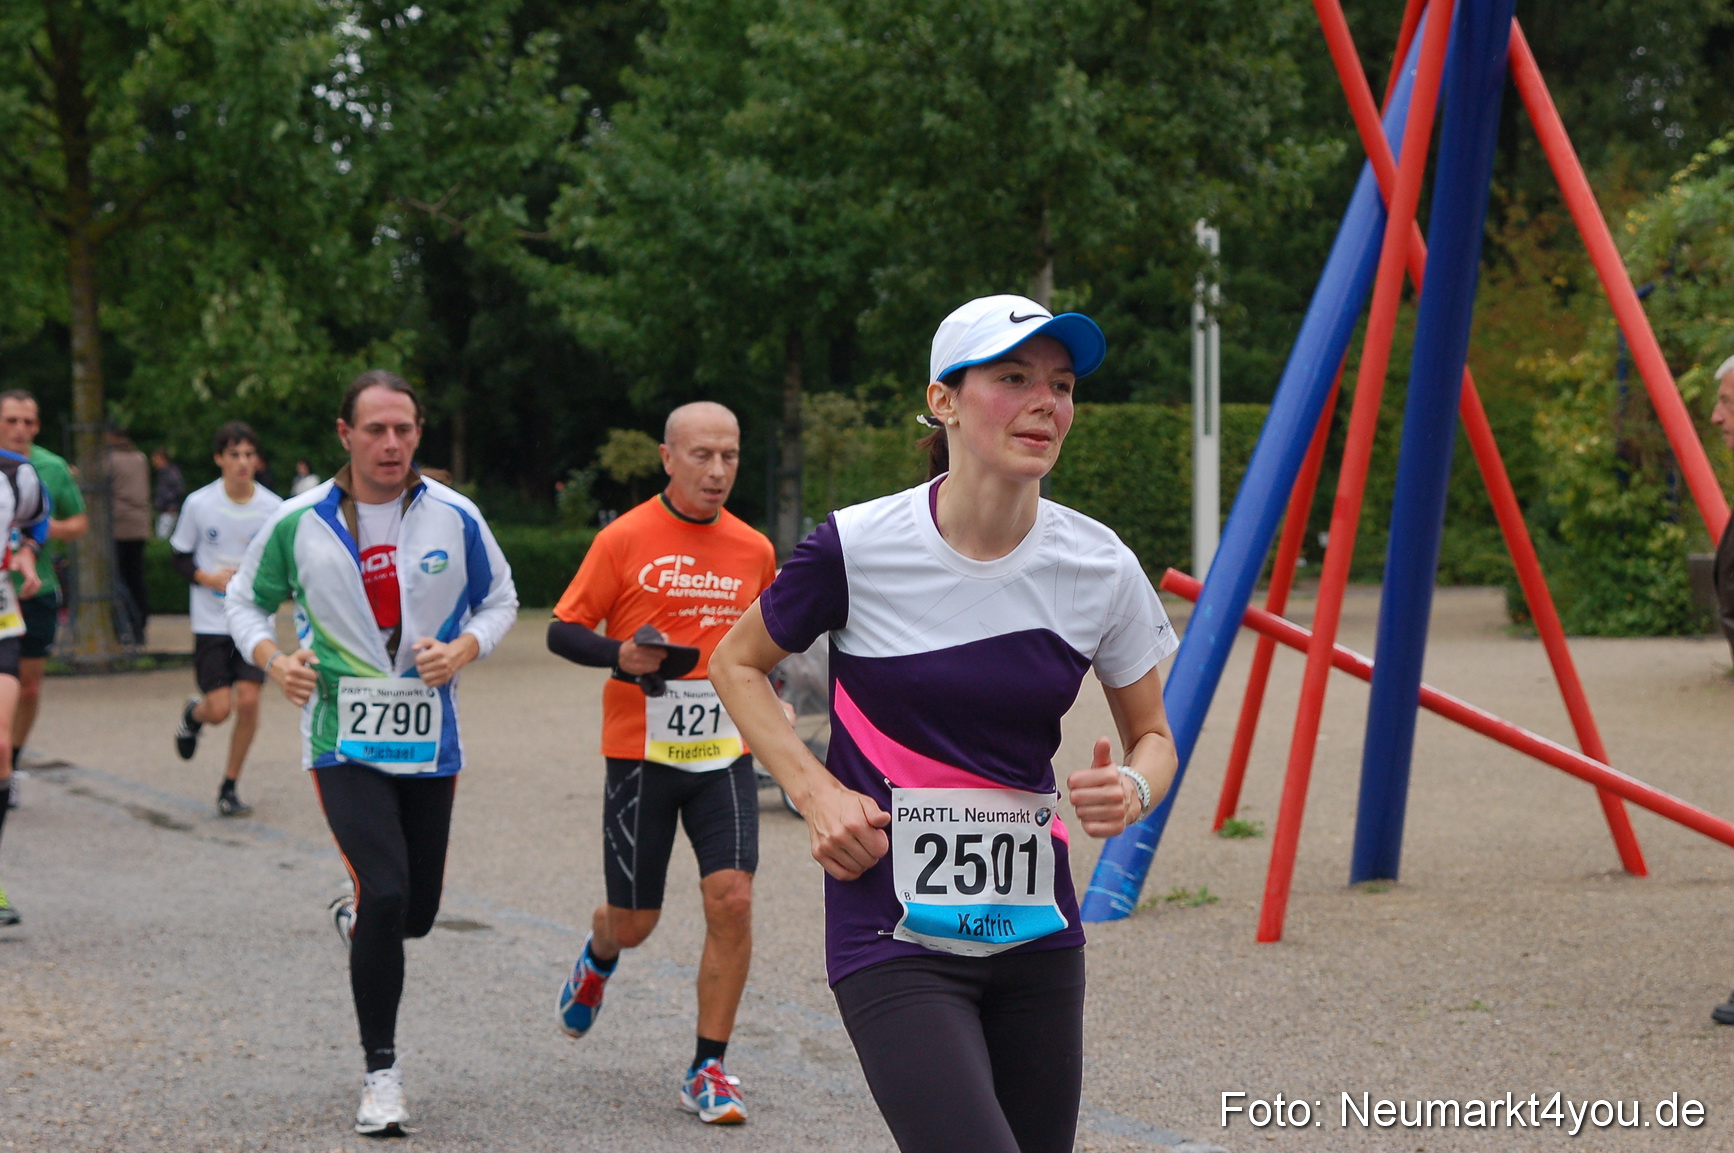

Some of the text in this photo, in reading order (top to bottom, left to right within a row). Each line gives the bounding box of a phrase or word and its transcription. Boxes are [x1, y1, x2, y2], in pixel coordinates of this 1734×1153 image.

[658, 568, 742, 591] Fischer
[666, 589, 736, 600] AUTOMOBILE
[350, 701, 431, 736] 2790
[667, 703, 721, 736] 421
[668, 744, 720, 759] Friedrich
[897, 807, 1031, 824] PARTL Neumarkt
[913, 832, 1038, 896] 2501
[957, 913, 1016, 937] Katrin
